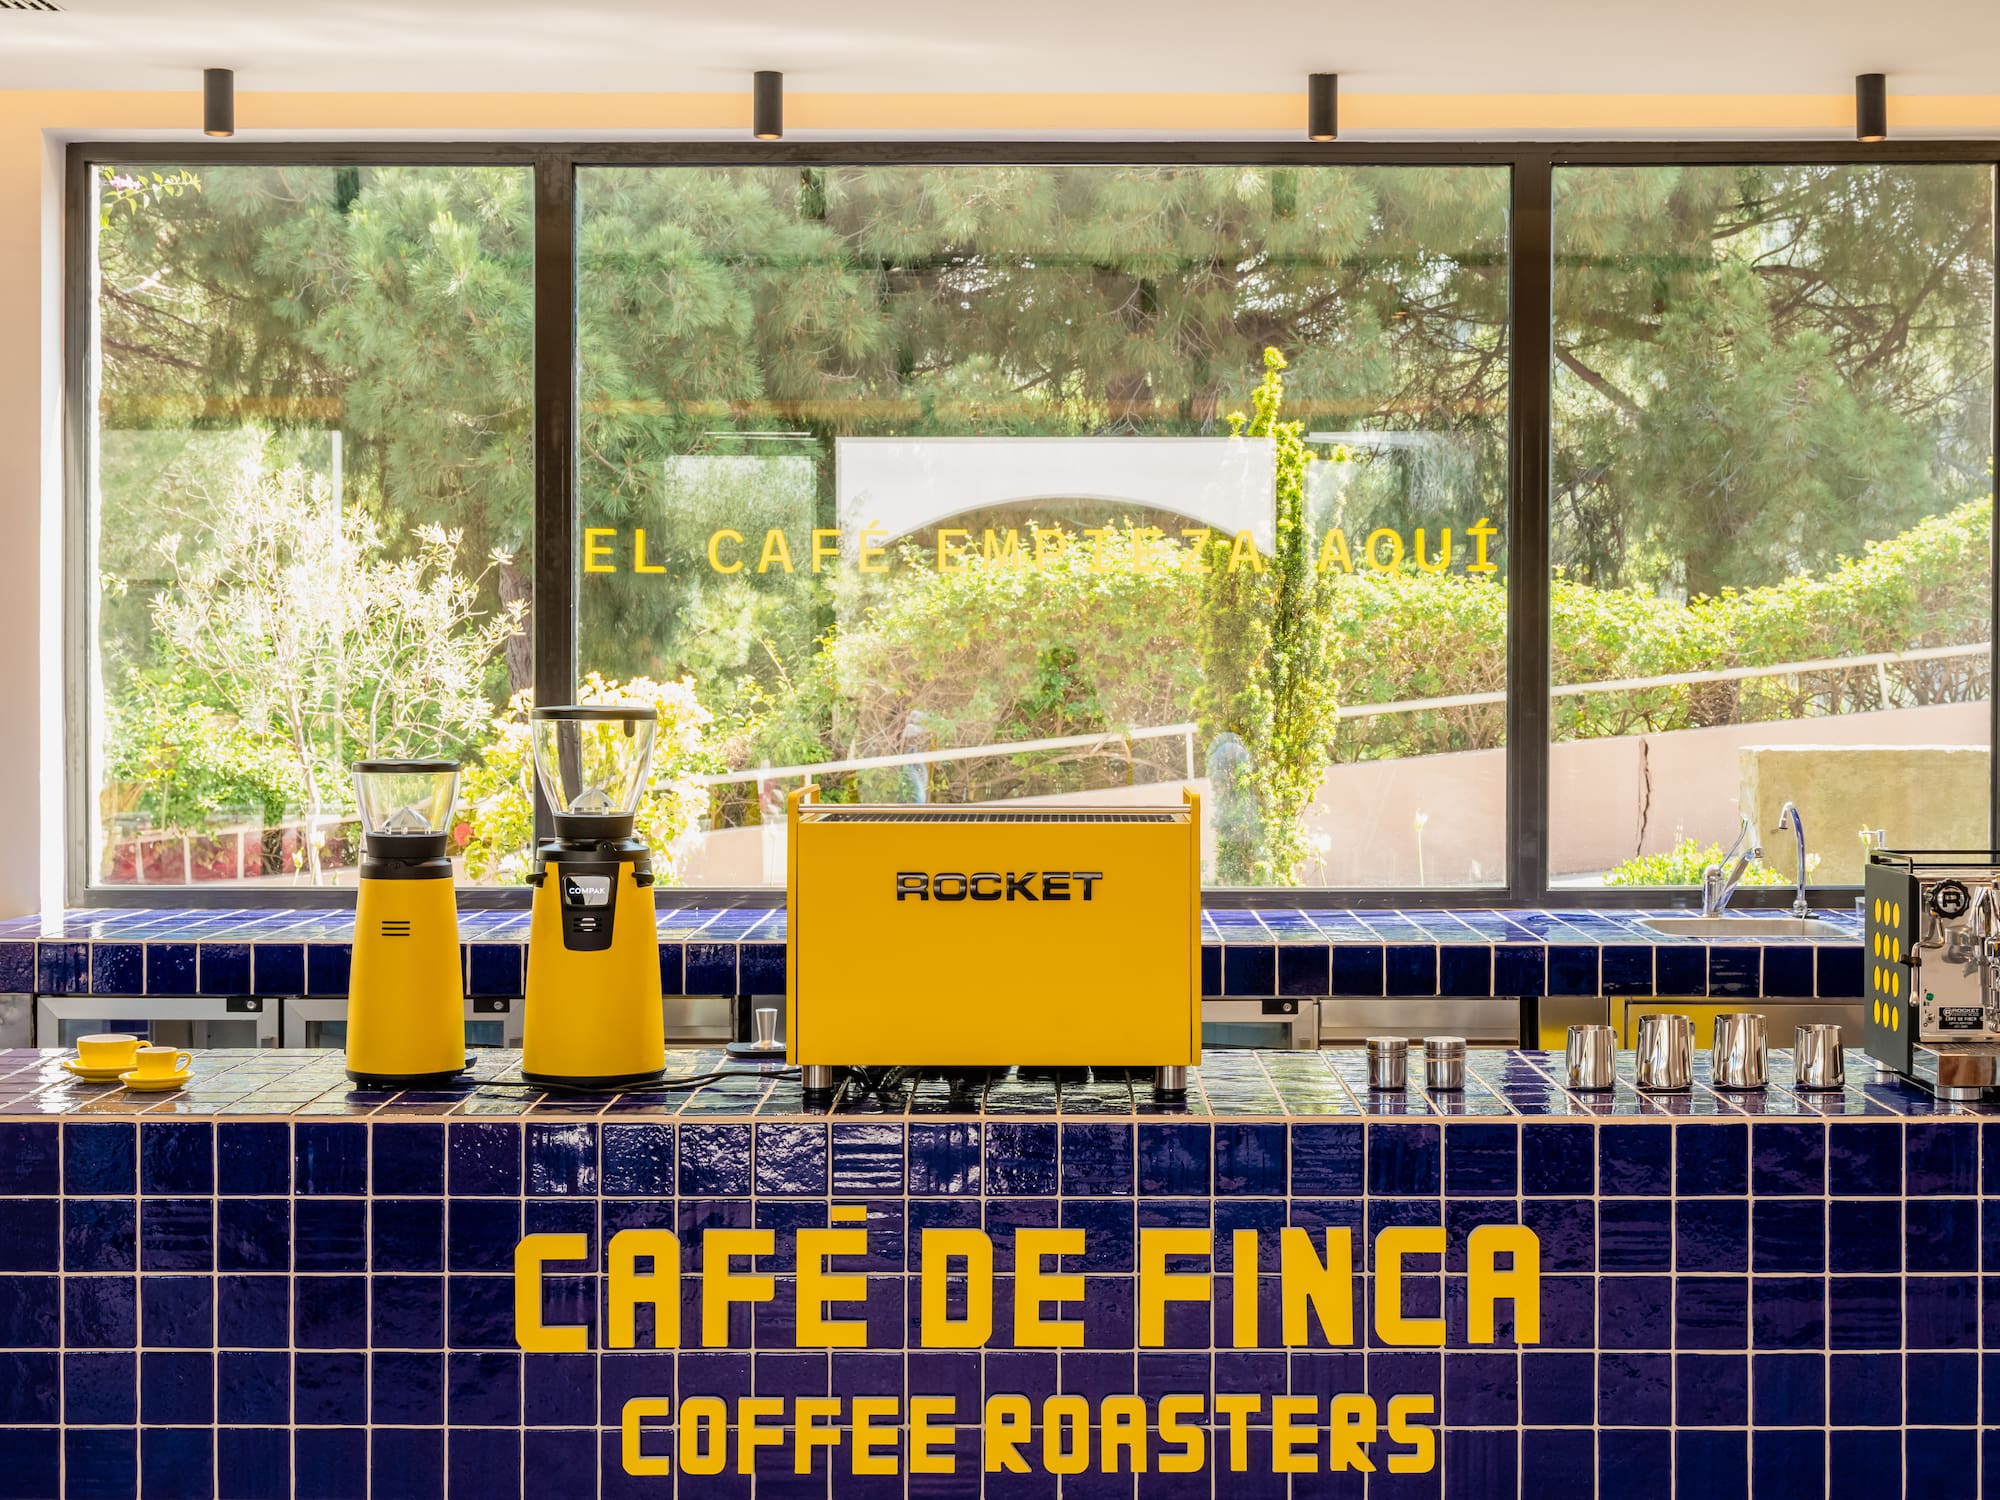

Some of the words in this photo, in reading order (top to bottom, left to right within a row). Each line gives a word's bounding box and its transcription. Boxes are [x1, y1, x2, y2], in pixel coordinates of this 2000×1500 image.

[584, 528, 667, 573] EL
[707, 519, 890, 574] CAFÉ
[937, 528, 1264, 573] EMPIEZA
[1318, 517, 1498, 577] AQUÍ
[568, 887, 606, 895] COMPAK
[896, 871, 1104, 901] ROCKET
[514, 1204, 868, 1353] CAFÉ
[921, 1227, 1086, 1348] DE
[1139, 1224, 1540, 1348] FINCA
[622, 1396, 957, 1476] COFFEE
[985, 1393, 1436, 1474] ROASTERS
